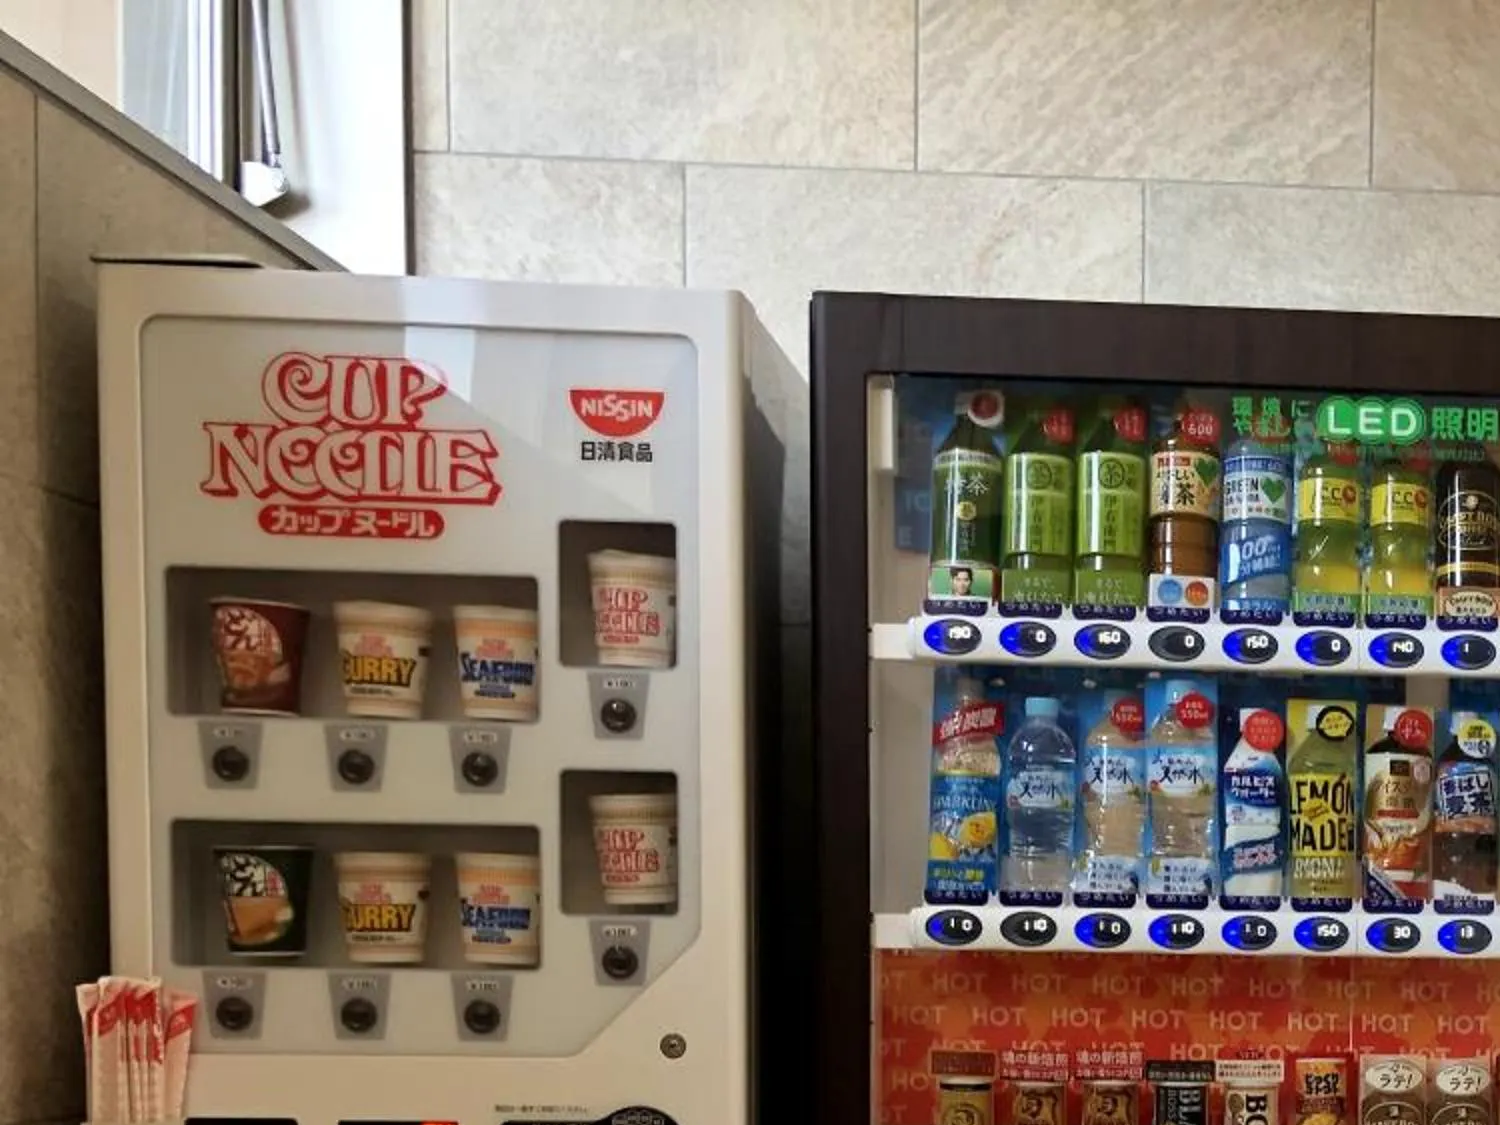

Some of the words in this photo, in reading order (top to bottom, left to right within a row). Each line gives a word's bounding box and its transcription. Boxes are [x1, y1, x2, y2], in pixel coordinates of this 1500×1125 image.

[261, 351, 449, 427] CUP
[580, 396, 654, 420] NISSIN
[1327, 406, 1418, 437] LED
[200, 420, 502, 506] NOODLE
[580, 441, 653, 463] 日清食品
